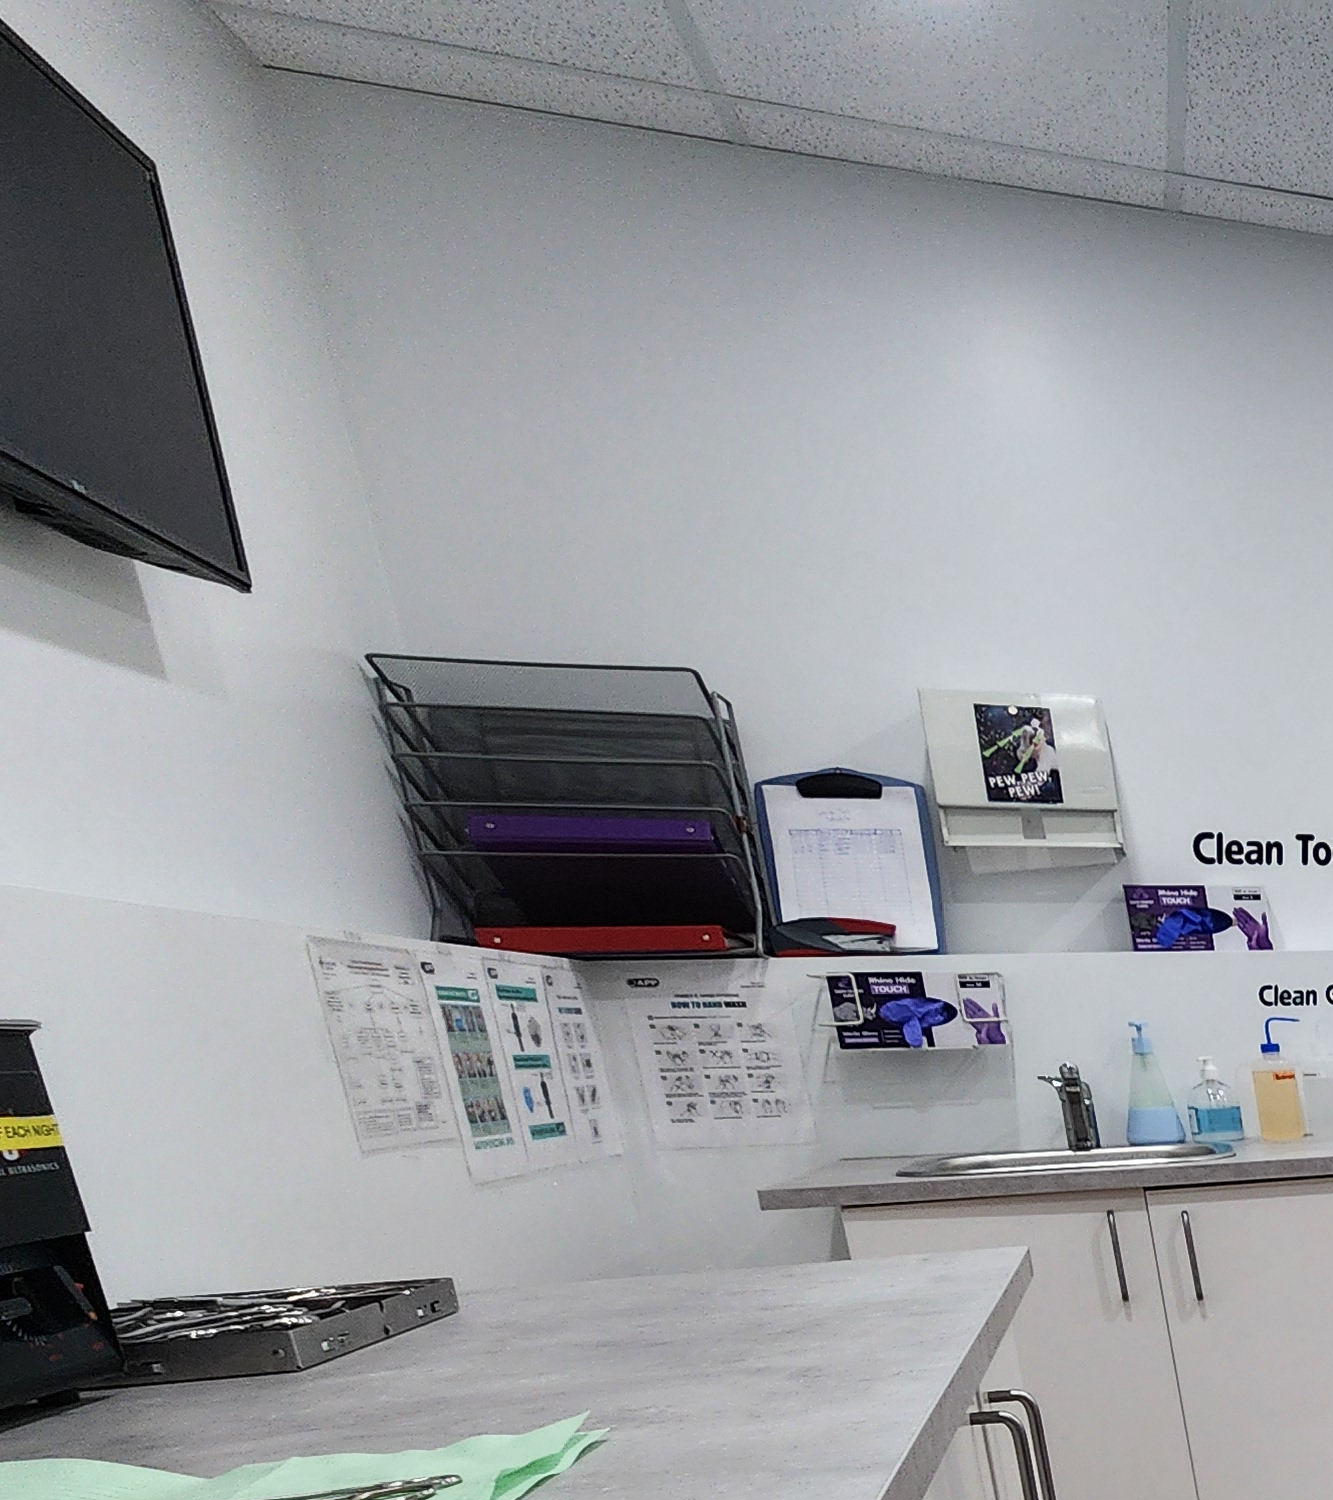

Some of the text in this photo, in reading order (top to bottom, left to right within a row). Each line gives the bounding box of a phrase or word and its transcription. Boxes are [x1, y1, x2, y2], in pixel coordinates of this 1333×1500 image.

[1008, 783, 1041, 799] PEW!
[1192, 831, 1284, 866] Clean
[1161, 896, 1191, 905] TOUCH
[873, 985, 907, 994] TOUCH
[1258, 984, 1318, 1007] Clean
[4, 1125, 31, 1139] EACH
[32, 1123, 60, 1137] NIGHT
